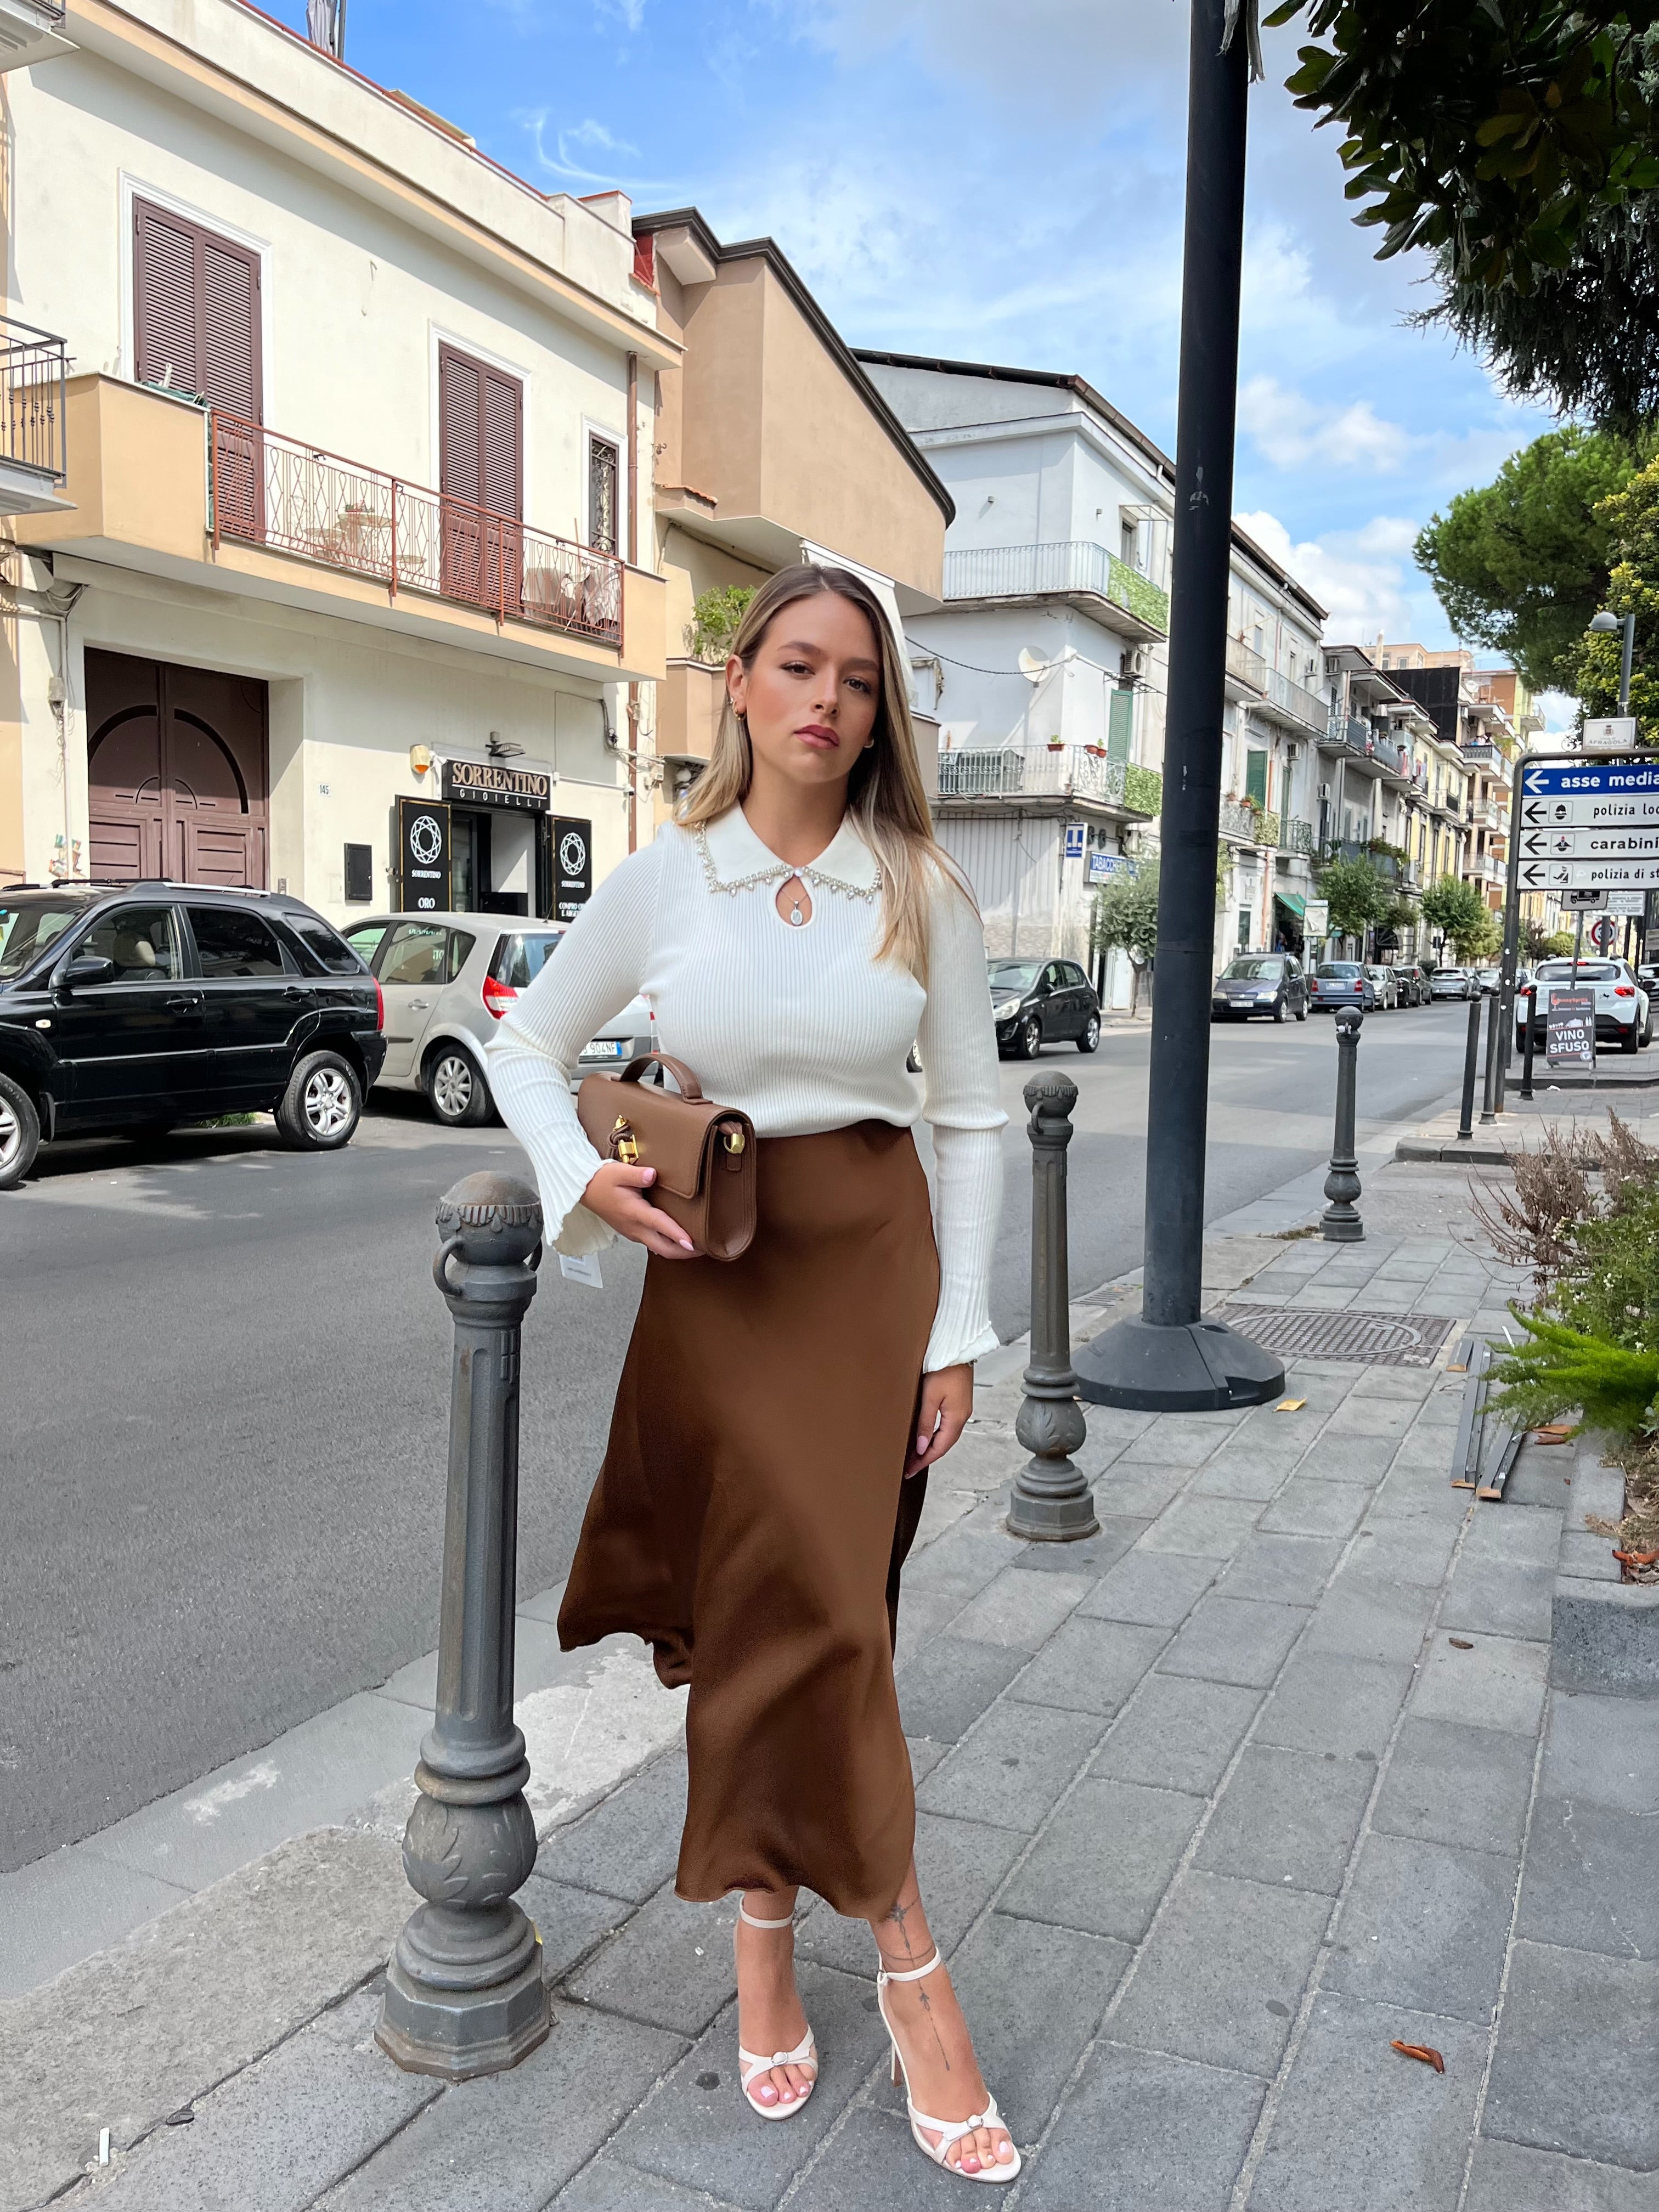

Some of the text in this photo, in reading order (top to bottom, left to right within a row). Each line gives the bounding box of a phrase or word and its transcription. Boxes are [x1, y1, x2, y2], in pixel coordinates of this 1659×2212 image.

[452, 762, 548, 795] SORRENTINO
[1561, 771, 1659, 788] asse media
[320, 784, 329, 794] 145
[460, 788, 541, 808] GIOIELLI
[1593, 803, 1635, 819] polizia
[1590, 837, 1659, 849] carabini
[411, 869, 442, 879] SORRENTINO
[1591, 868, 1629, 881] polizia
[1634, 868, 1644, 879] di
[417, 896, 436, 909] ORO
[1555, 1029, 1585, 1041] VINO
[1550, 1040, 1590, 1053] SFUSO
